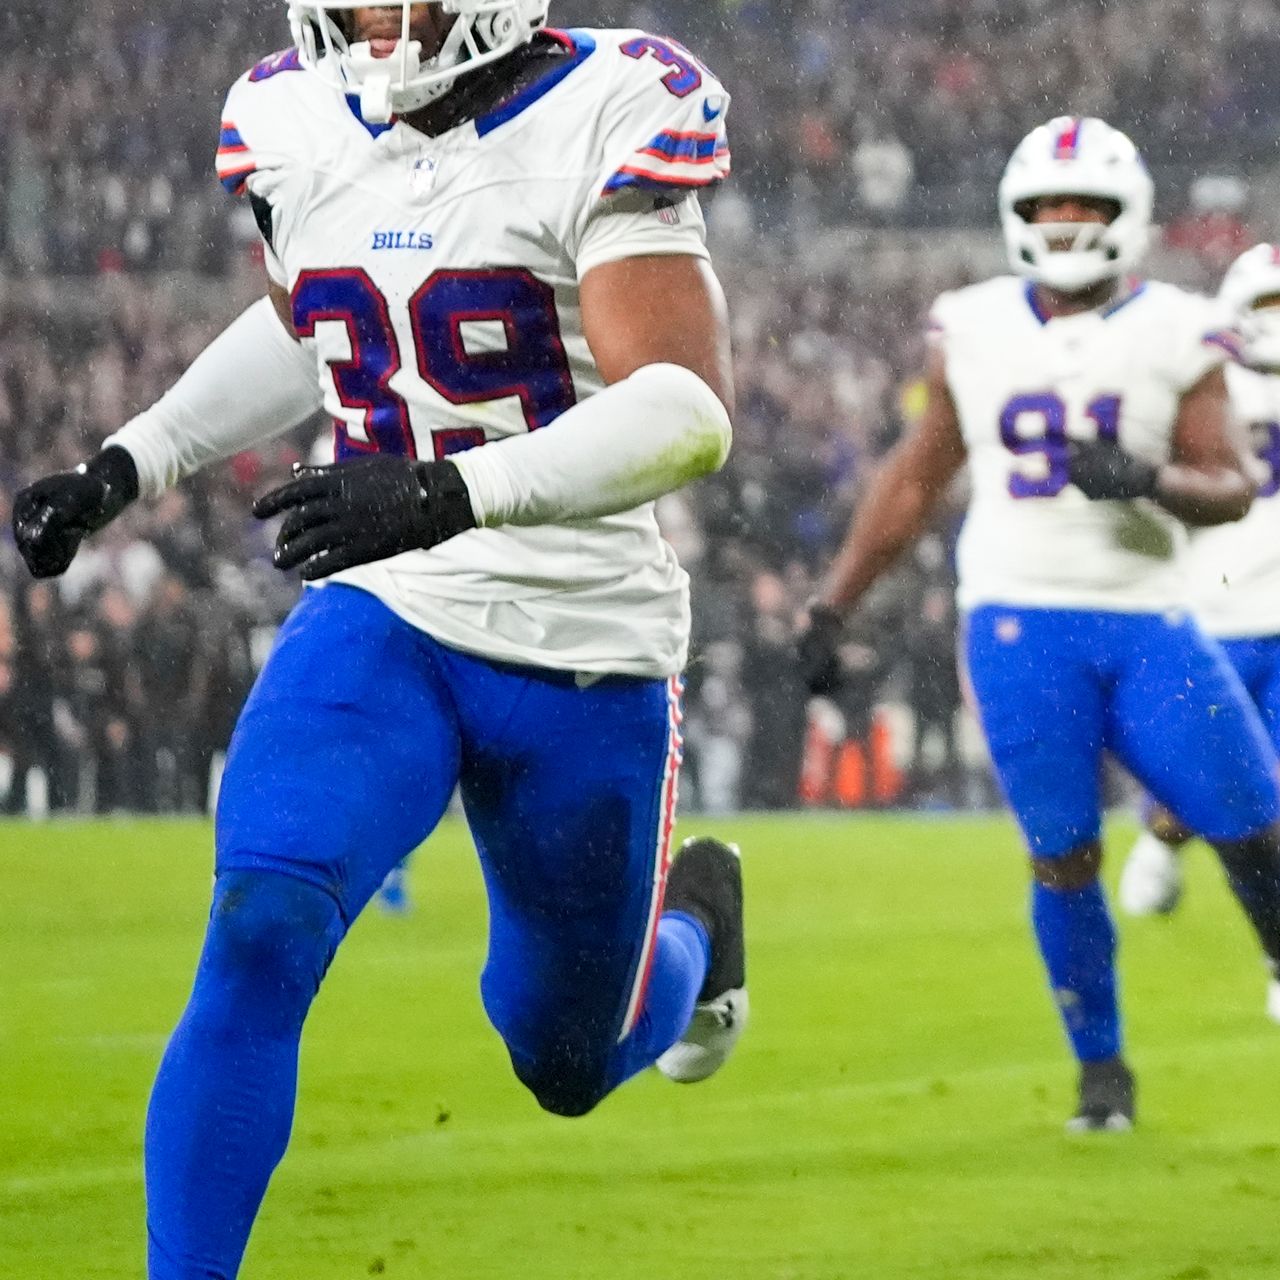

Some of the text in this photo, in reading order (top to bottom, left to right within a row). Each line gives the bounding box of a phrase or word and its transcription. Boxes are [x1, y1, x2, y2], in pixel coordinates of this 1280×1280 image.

[371, 231, 433, 250] BILLS
[290, 265, 577, 462] 39
[998, 391, 1121, 500] 91
